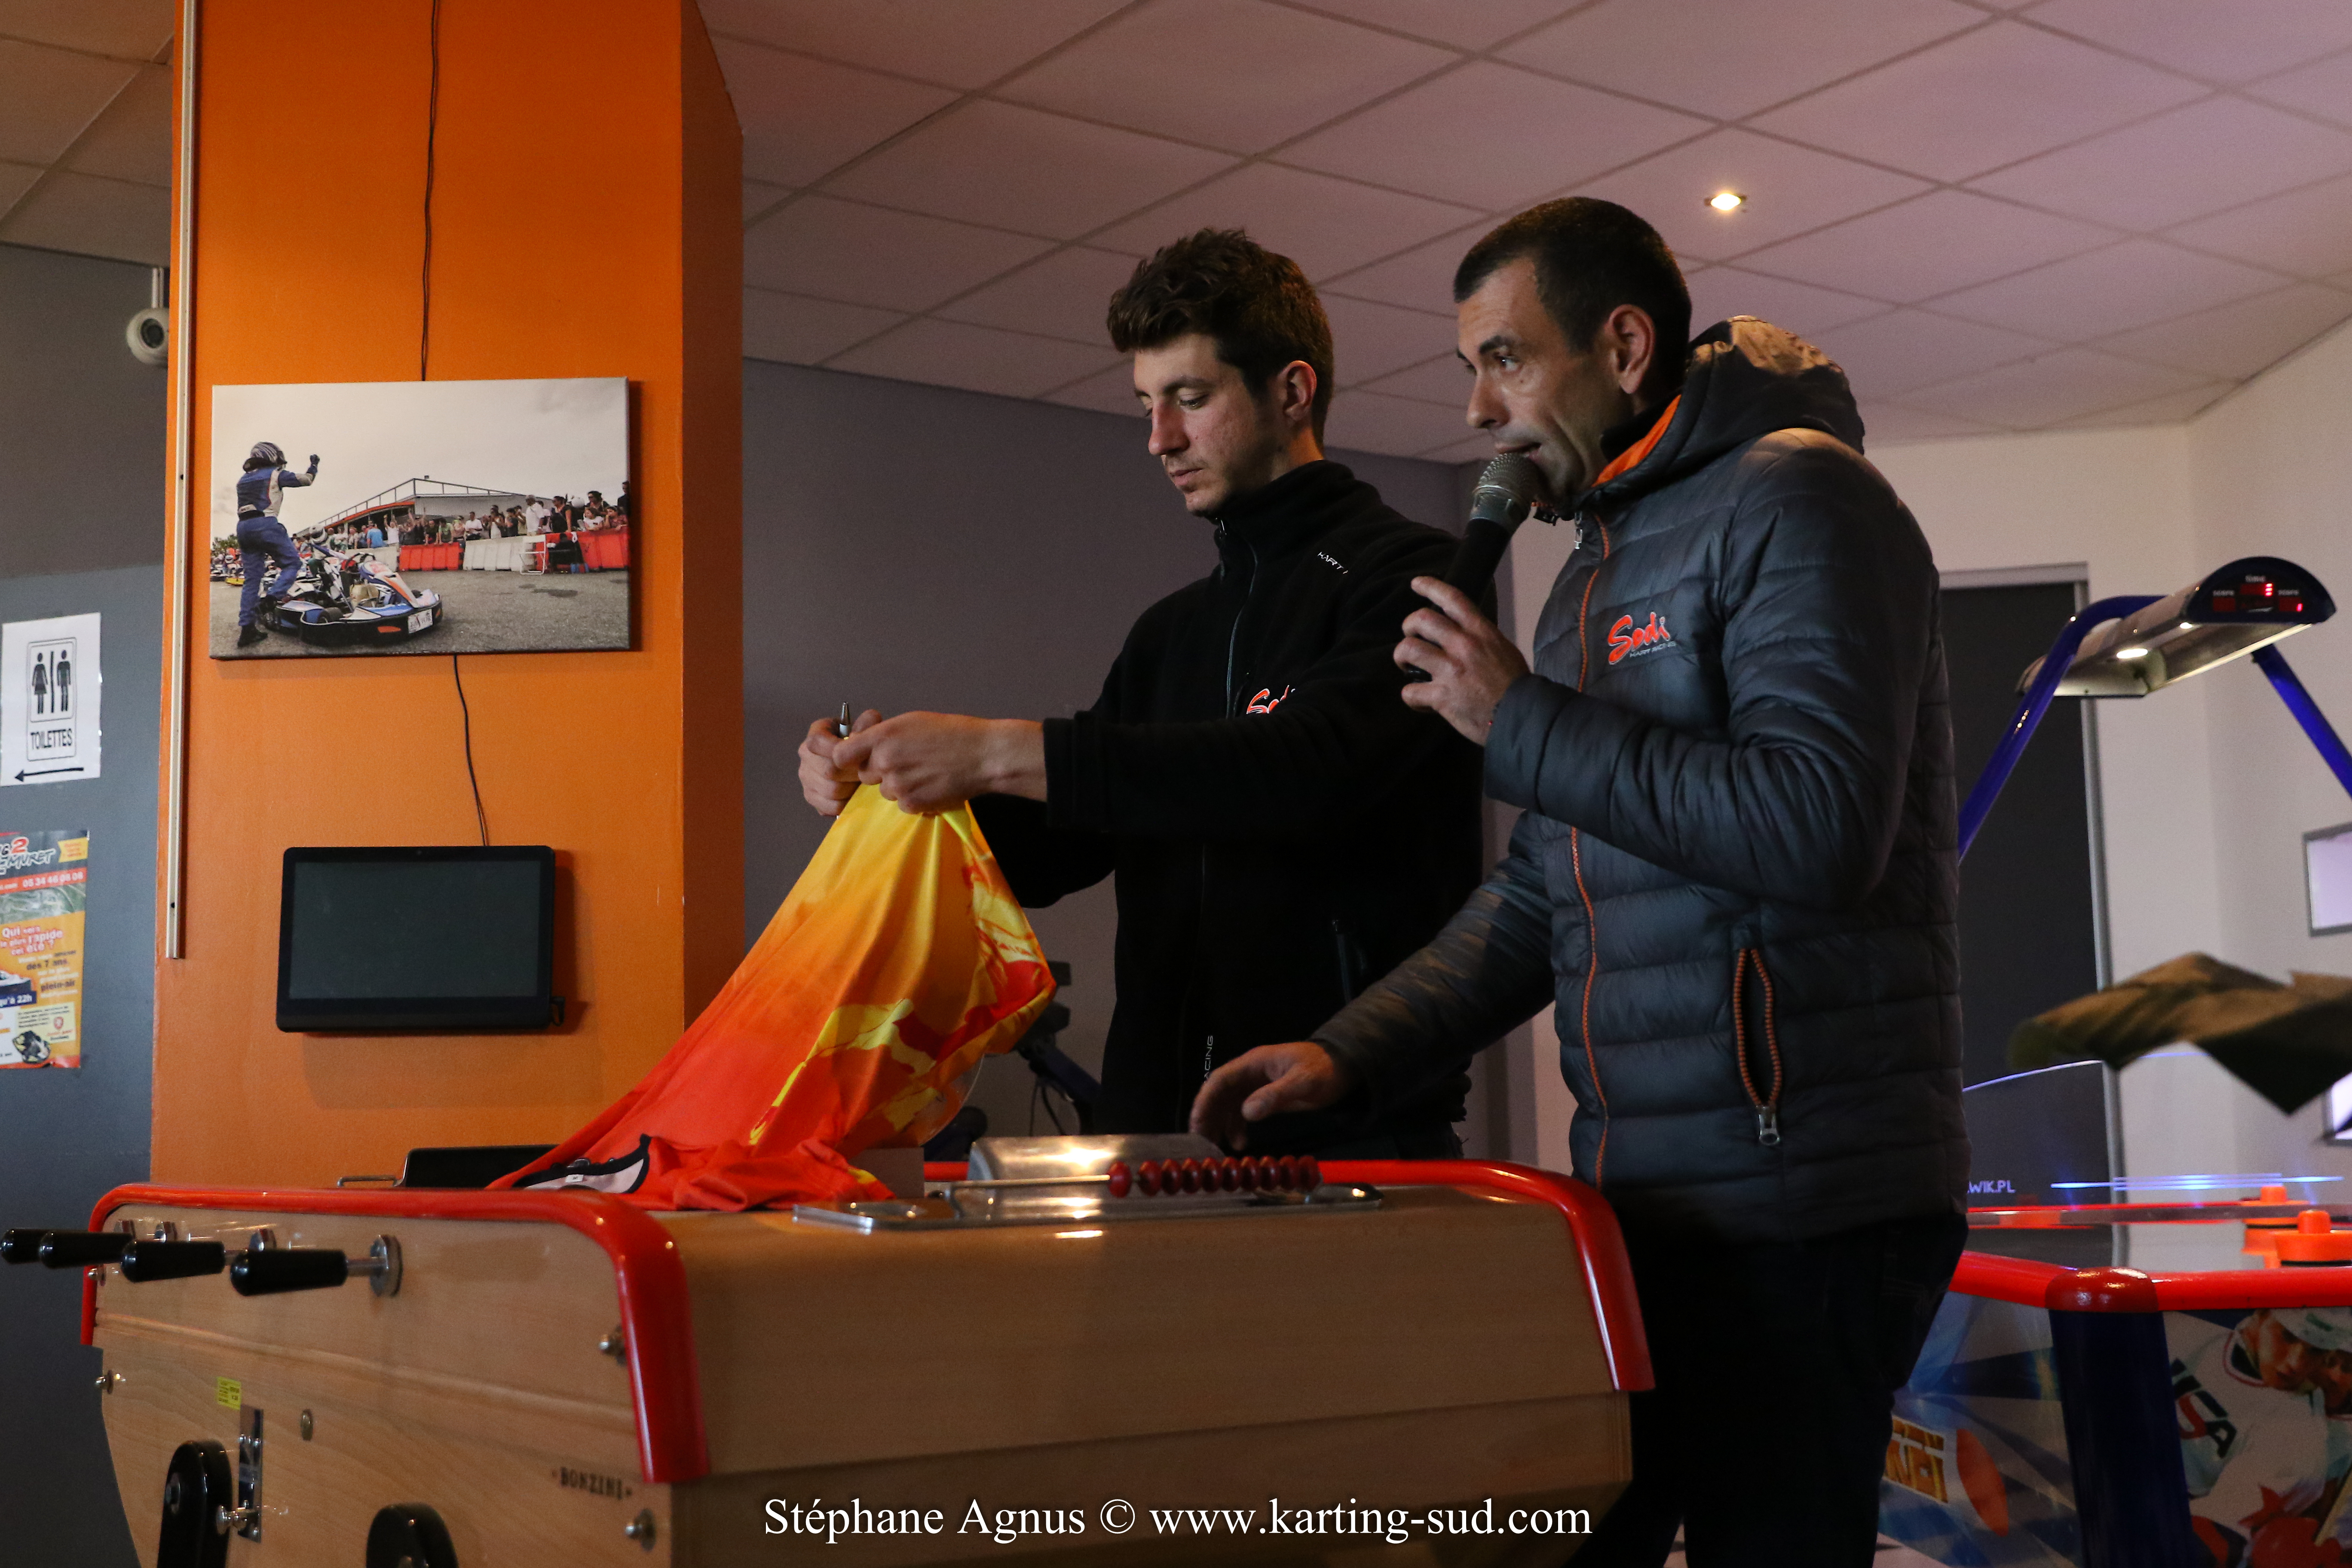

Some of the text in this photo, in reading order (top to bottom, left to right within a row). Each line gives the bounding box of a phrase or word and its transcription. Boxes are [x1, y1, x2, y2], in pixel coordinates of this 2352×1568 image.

[1608, 611, 1671, 665] Sodi
[31, 728, 72, 750] TOILETTES
[2, 925, 21, 939] Qui
[1204, 1035, 1213, 1083] ACING
